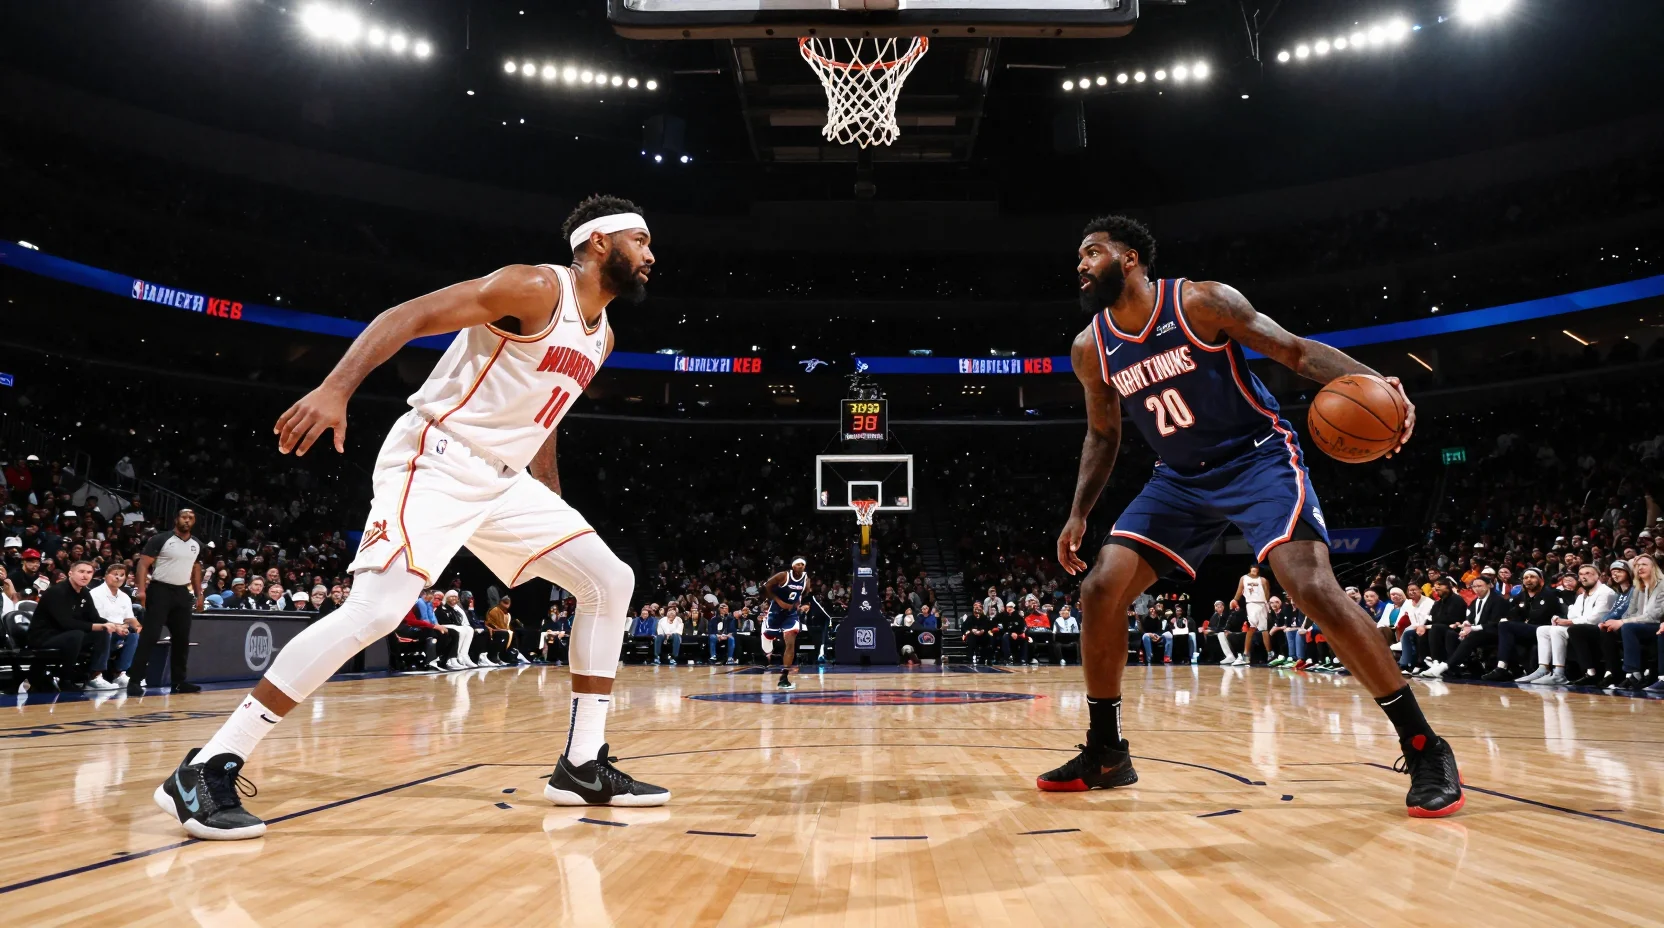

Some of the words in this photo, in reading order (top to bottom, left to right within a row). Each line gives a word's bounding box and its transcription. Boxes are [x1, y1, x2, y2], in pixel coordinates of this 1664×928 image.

[534, 386, 570, 429] 10
[853, 416, 877, 431] 38
[1144, 387, 1195, 437] 20
